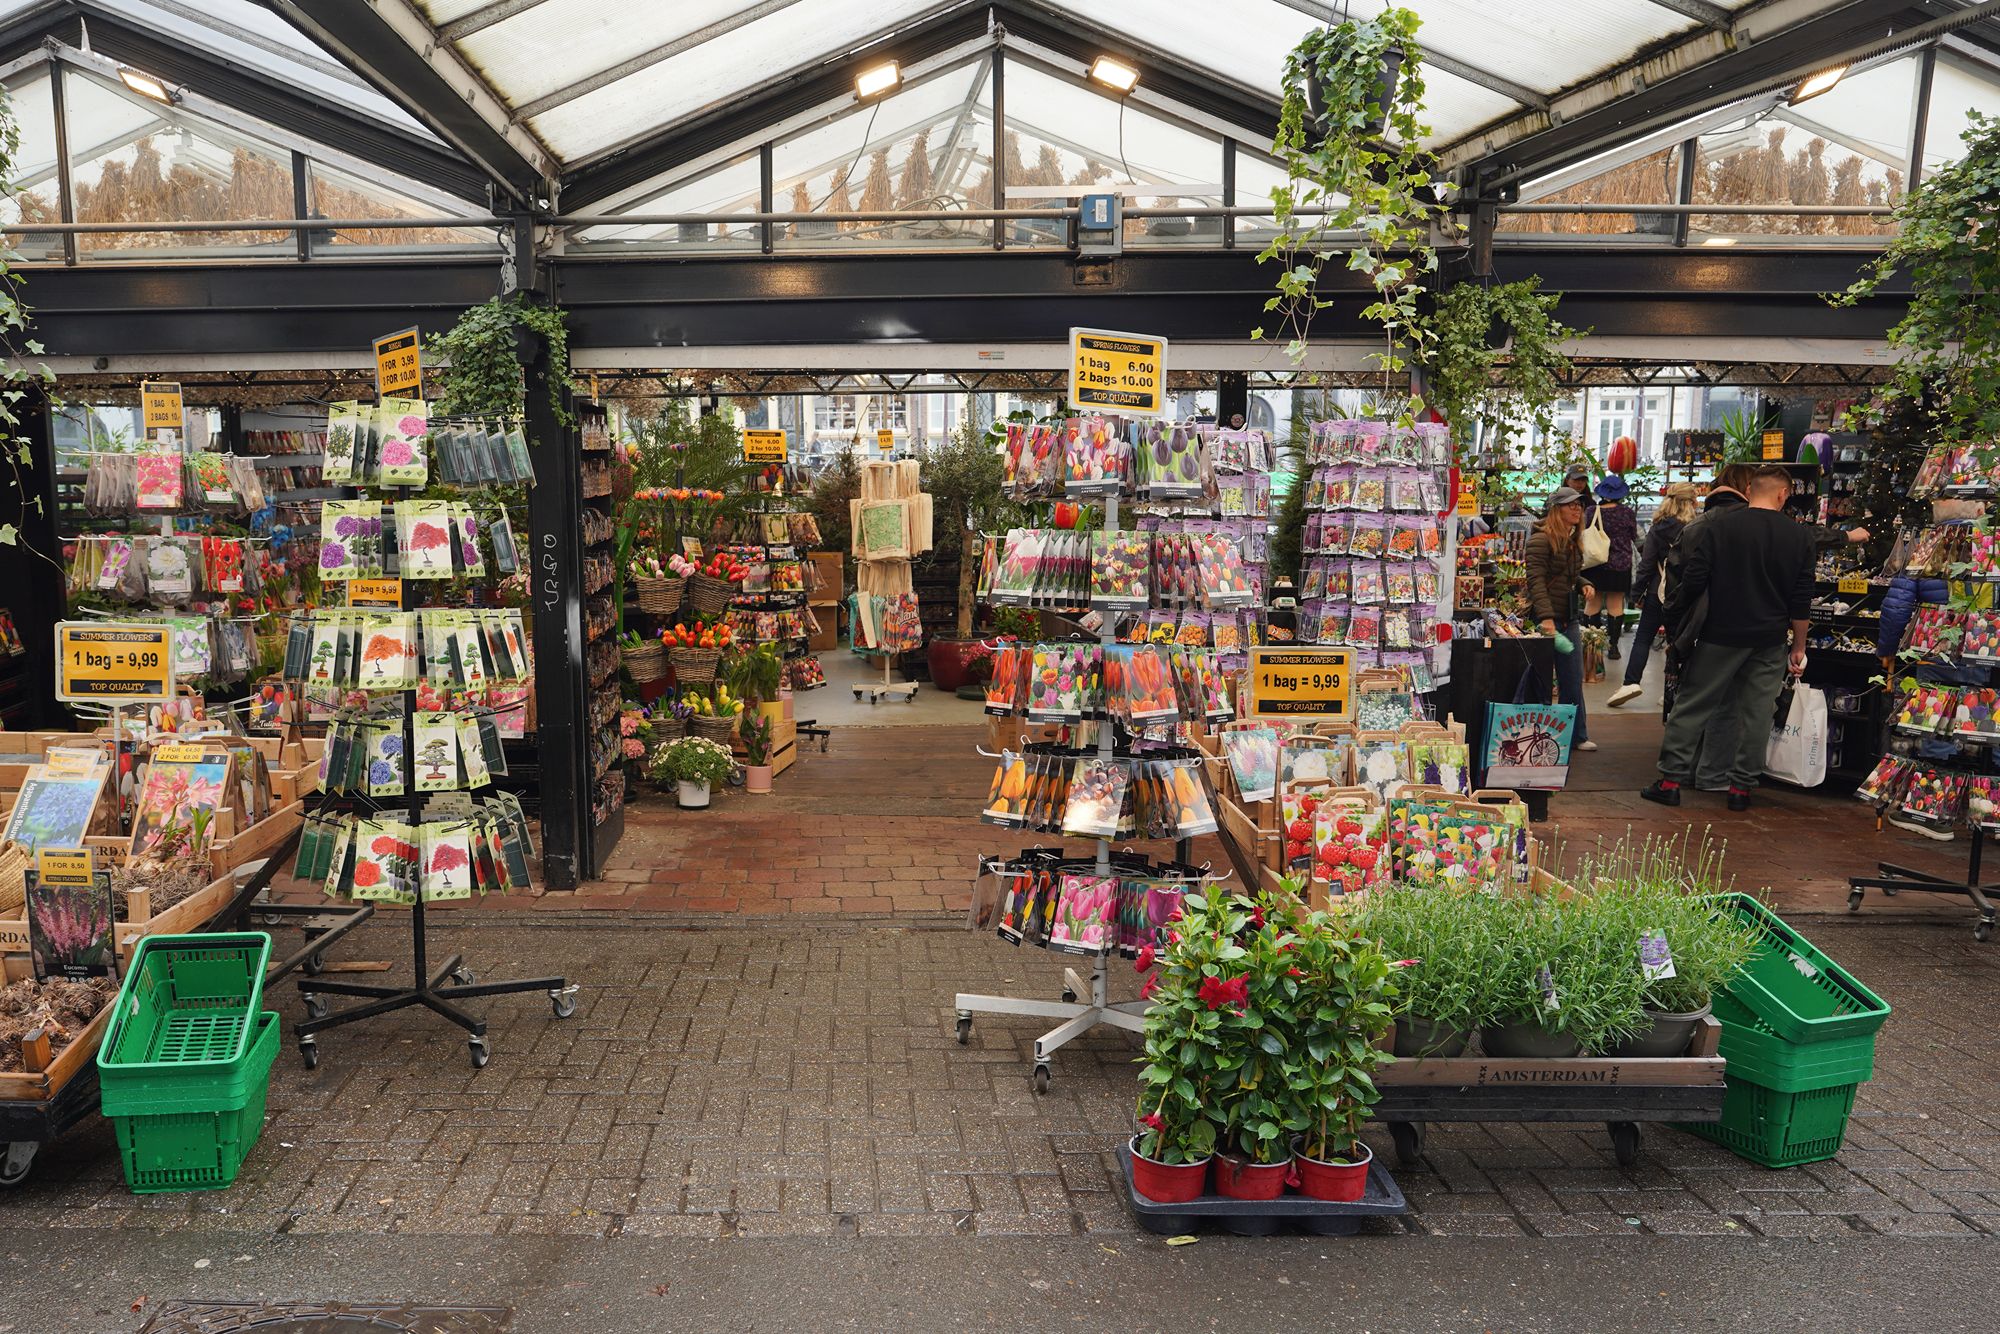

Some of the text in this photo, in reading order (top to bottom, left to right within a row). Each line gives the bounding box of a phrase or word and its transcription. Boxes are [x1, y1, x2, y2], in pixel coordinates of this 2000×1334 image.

[1093, 341, 1140, 352] SPRING FLOWERS
[385, 359, 396, 370] FOR
[401, 354, 414, 367] 3,99
[1080, 356, 1154, 373] 1 bag 6.00
[387, 374, 398, 384] FOR
[1079, 371, 1153, 387] 2 bags 10.00
[1093, 392, 1141, 404] TOP QUALITY
[360, 585, 373, 594] bag
[382, 586, 397, 595] 9,99
[80, 632, 154, 641] SUMMER FLOWERS
[74, 651, 158, 670] 1 bag = 9,99
[1270, 656, 1336, 664] SUMMER FLOWERS
[90, 683, 145, 691] TOP QUALITY
[1263, 674, 1340, 691] 1 bag = 9,99
[1277, 703, 1326, 711] TOP QUALITY
[1501, 712, 1566, 732] AMSTERDAM
[9, 782, 38, 839] Agapanthus Blauw
[1490, 1070, 1606, 1081] AMSTERDAM
